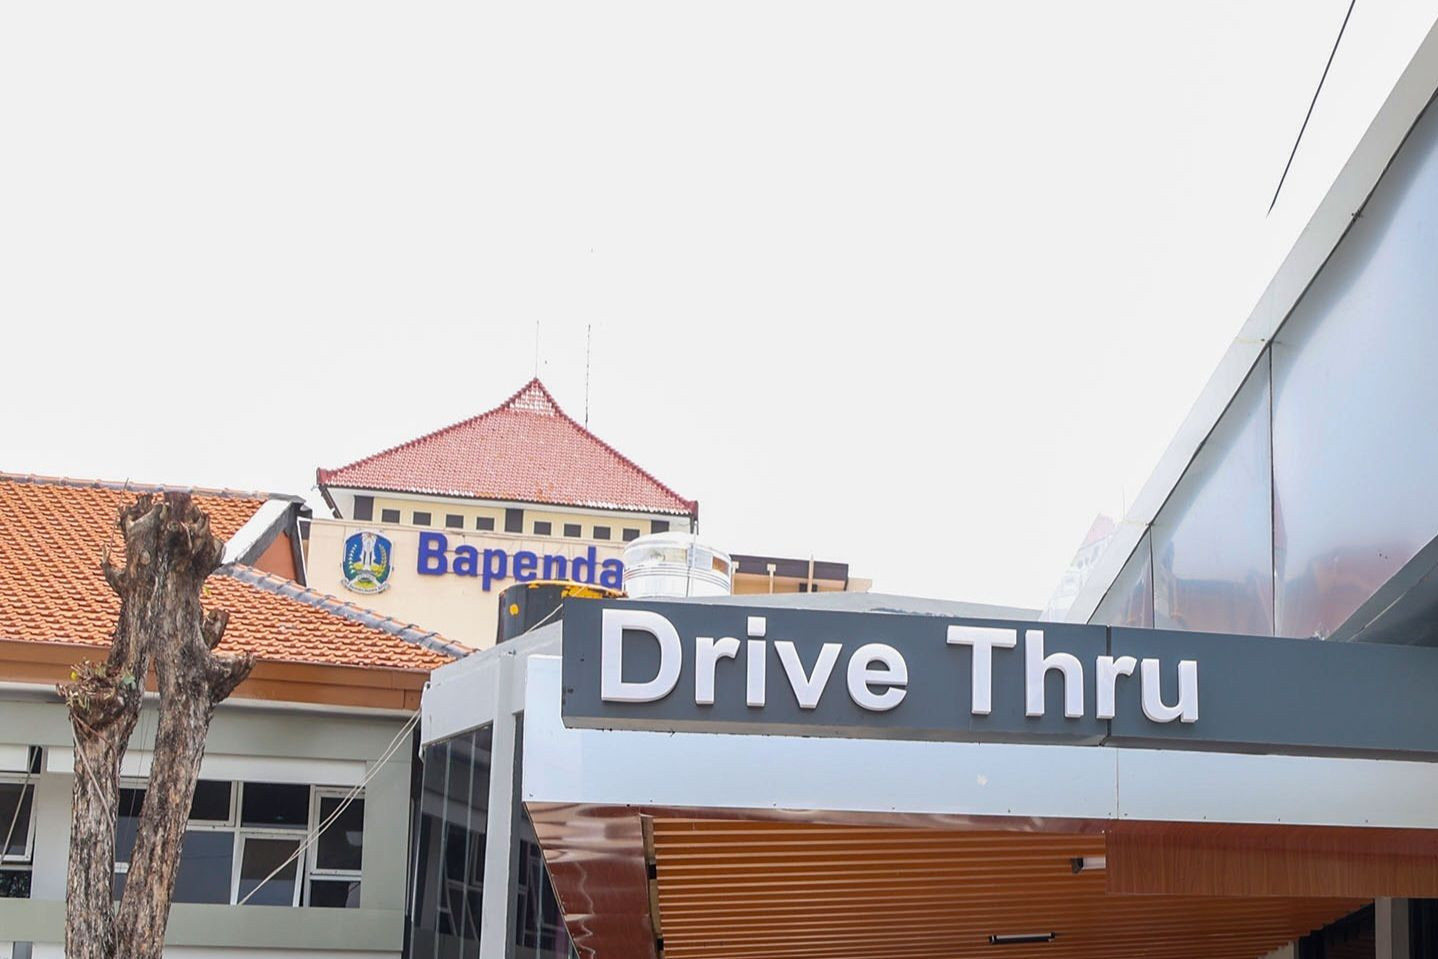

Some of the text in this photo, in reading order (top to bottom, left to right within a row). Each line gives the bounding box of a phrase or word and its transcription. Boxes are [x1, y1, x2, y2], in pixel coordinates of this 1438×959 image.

[417, 532, 625, 591] Bapenda
[602, 609, 1199, 723] Drive Thru
